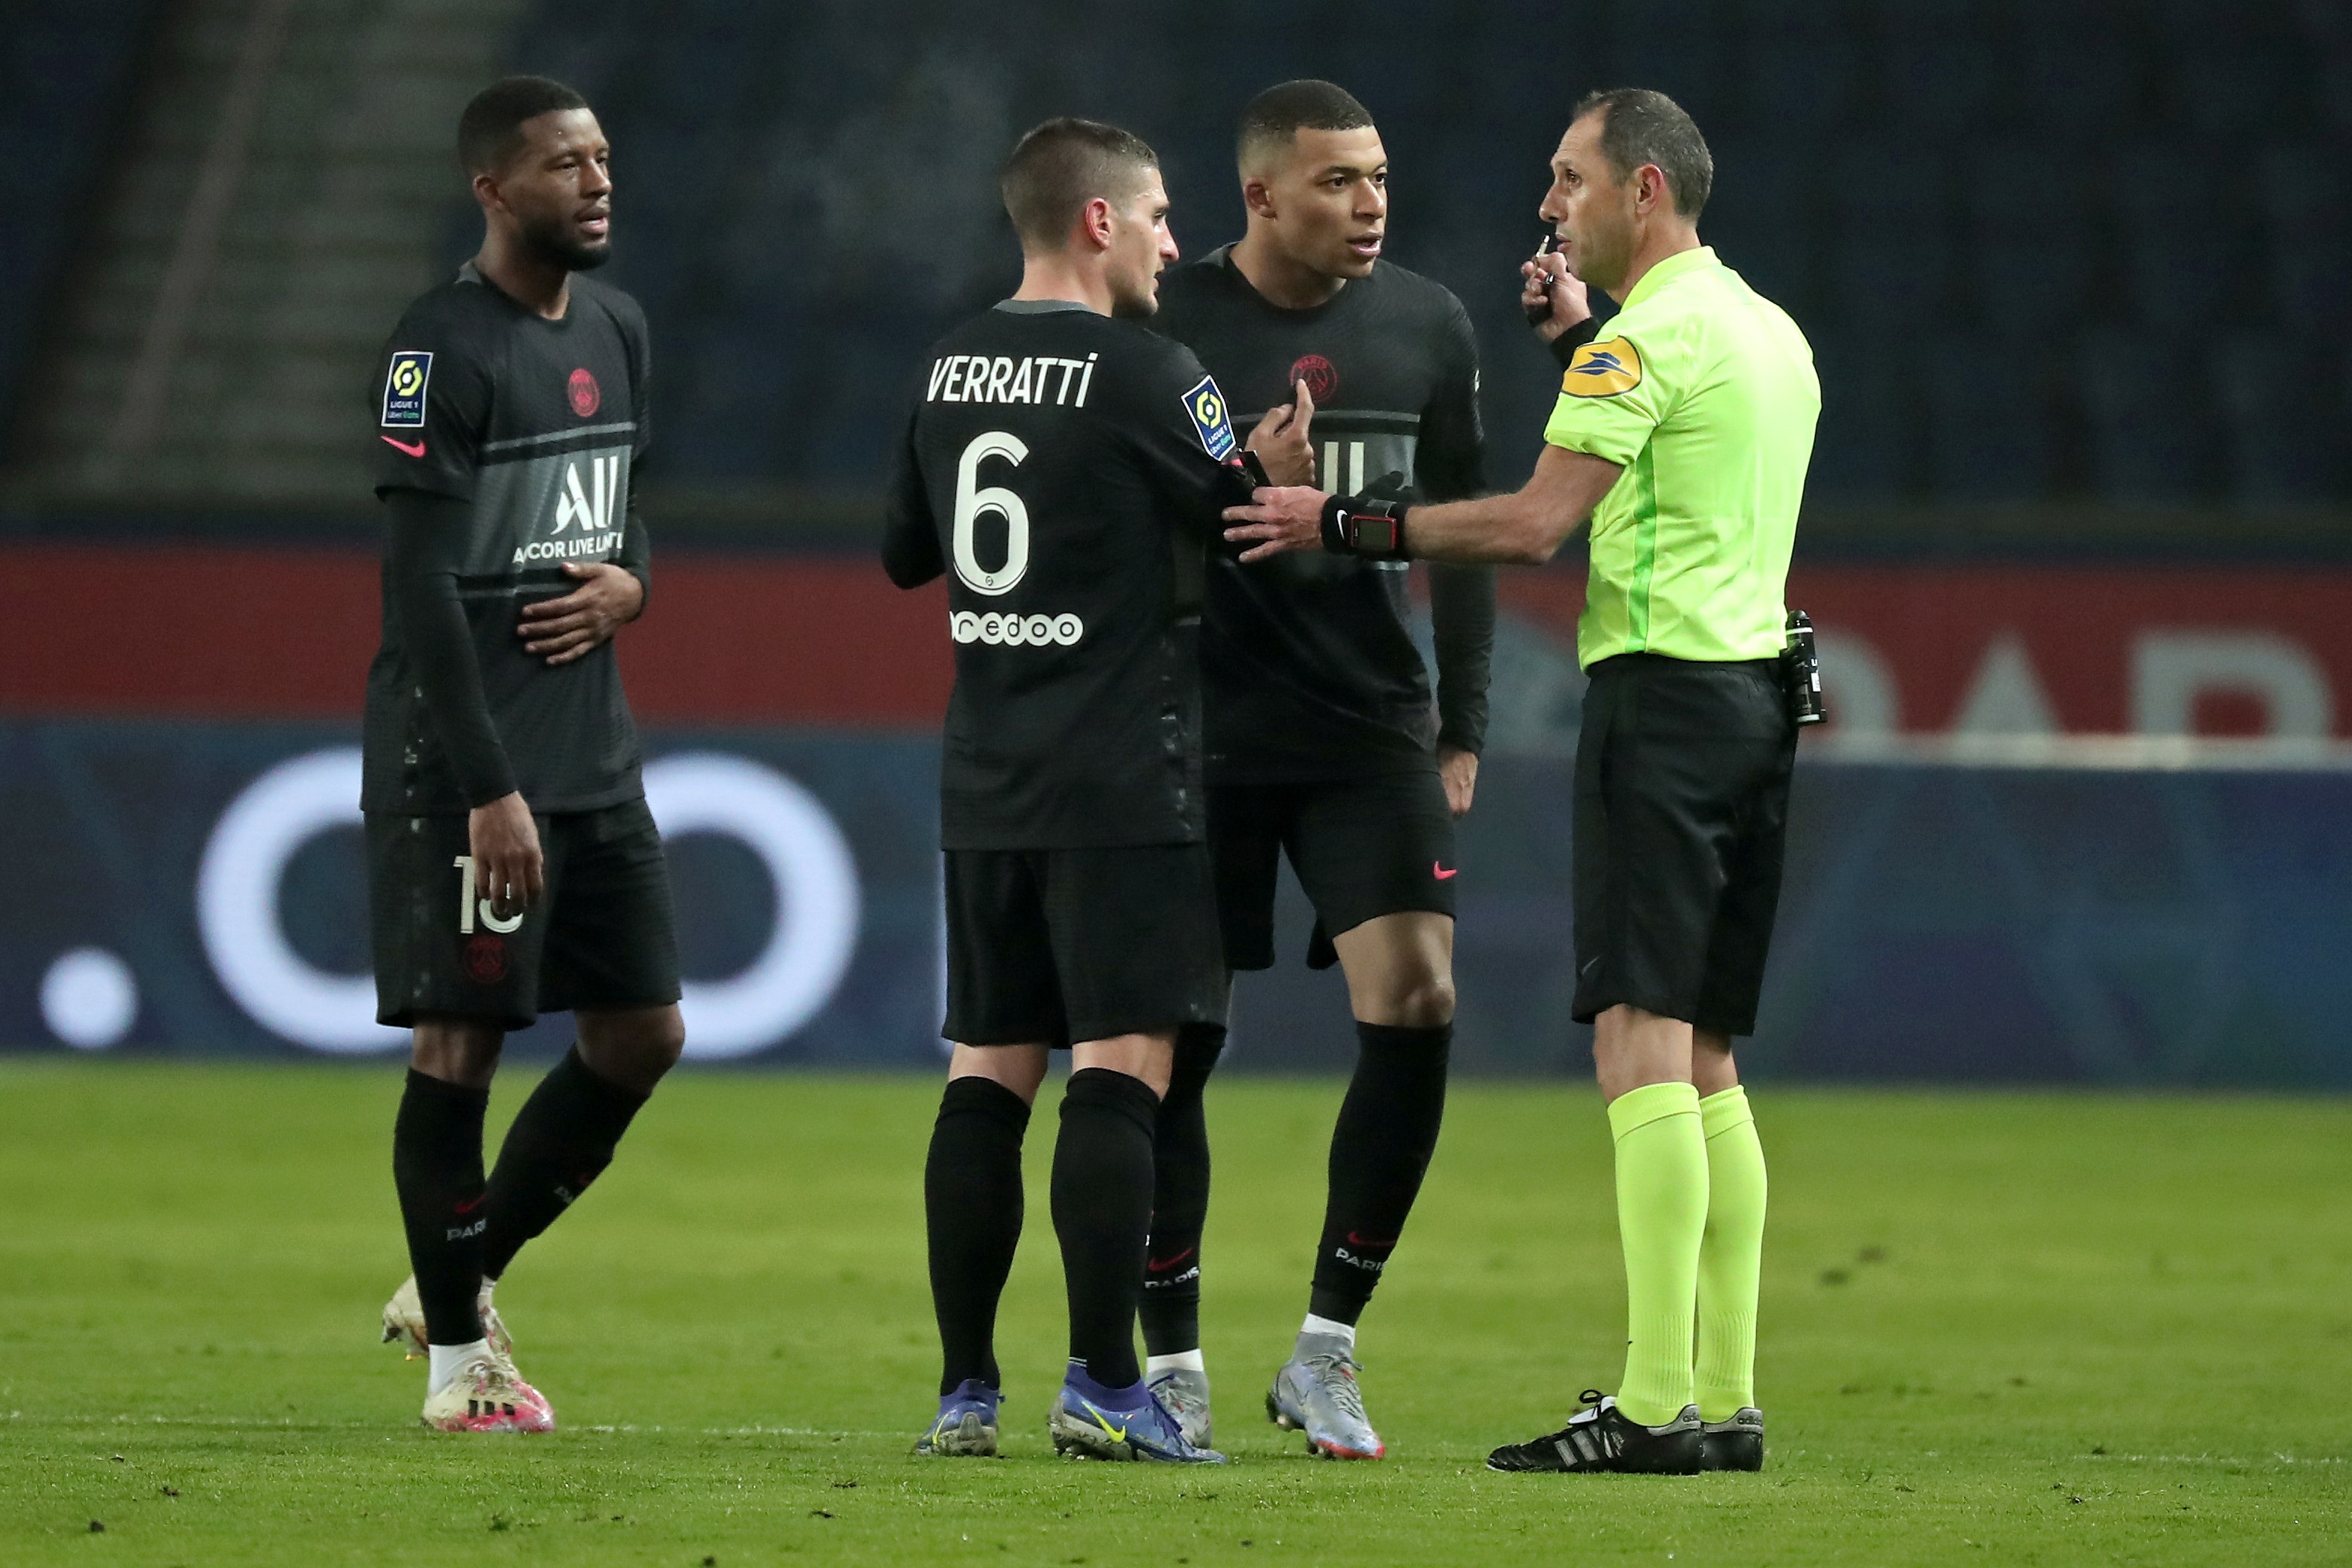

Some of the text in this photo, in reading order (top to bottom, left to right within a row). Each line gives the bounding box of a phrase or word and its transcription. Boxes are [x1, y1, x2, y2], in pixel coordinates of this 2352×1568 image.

[1208, 429, 1224, 445] LIGUE
[953, 431, 1030, 597] 6
[568, 537, 595, 557] LIVE
